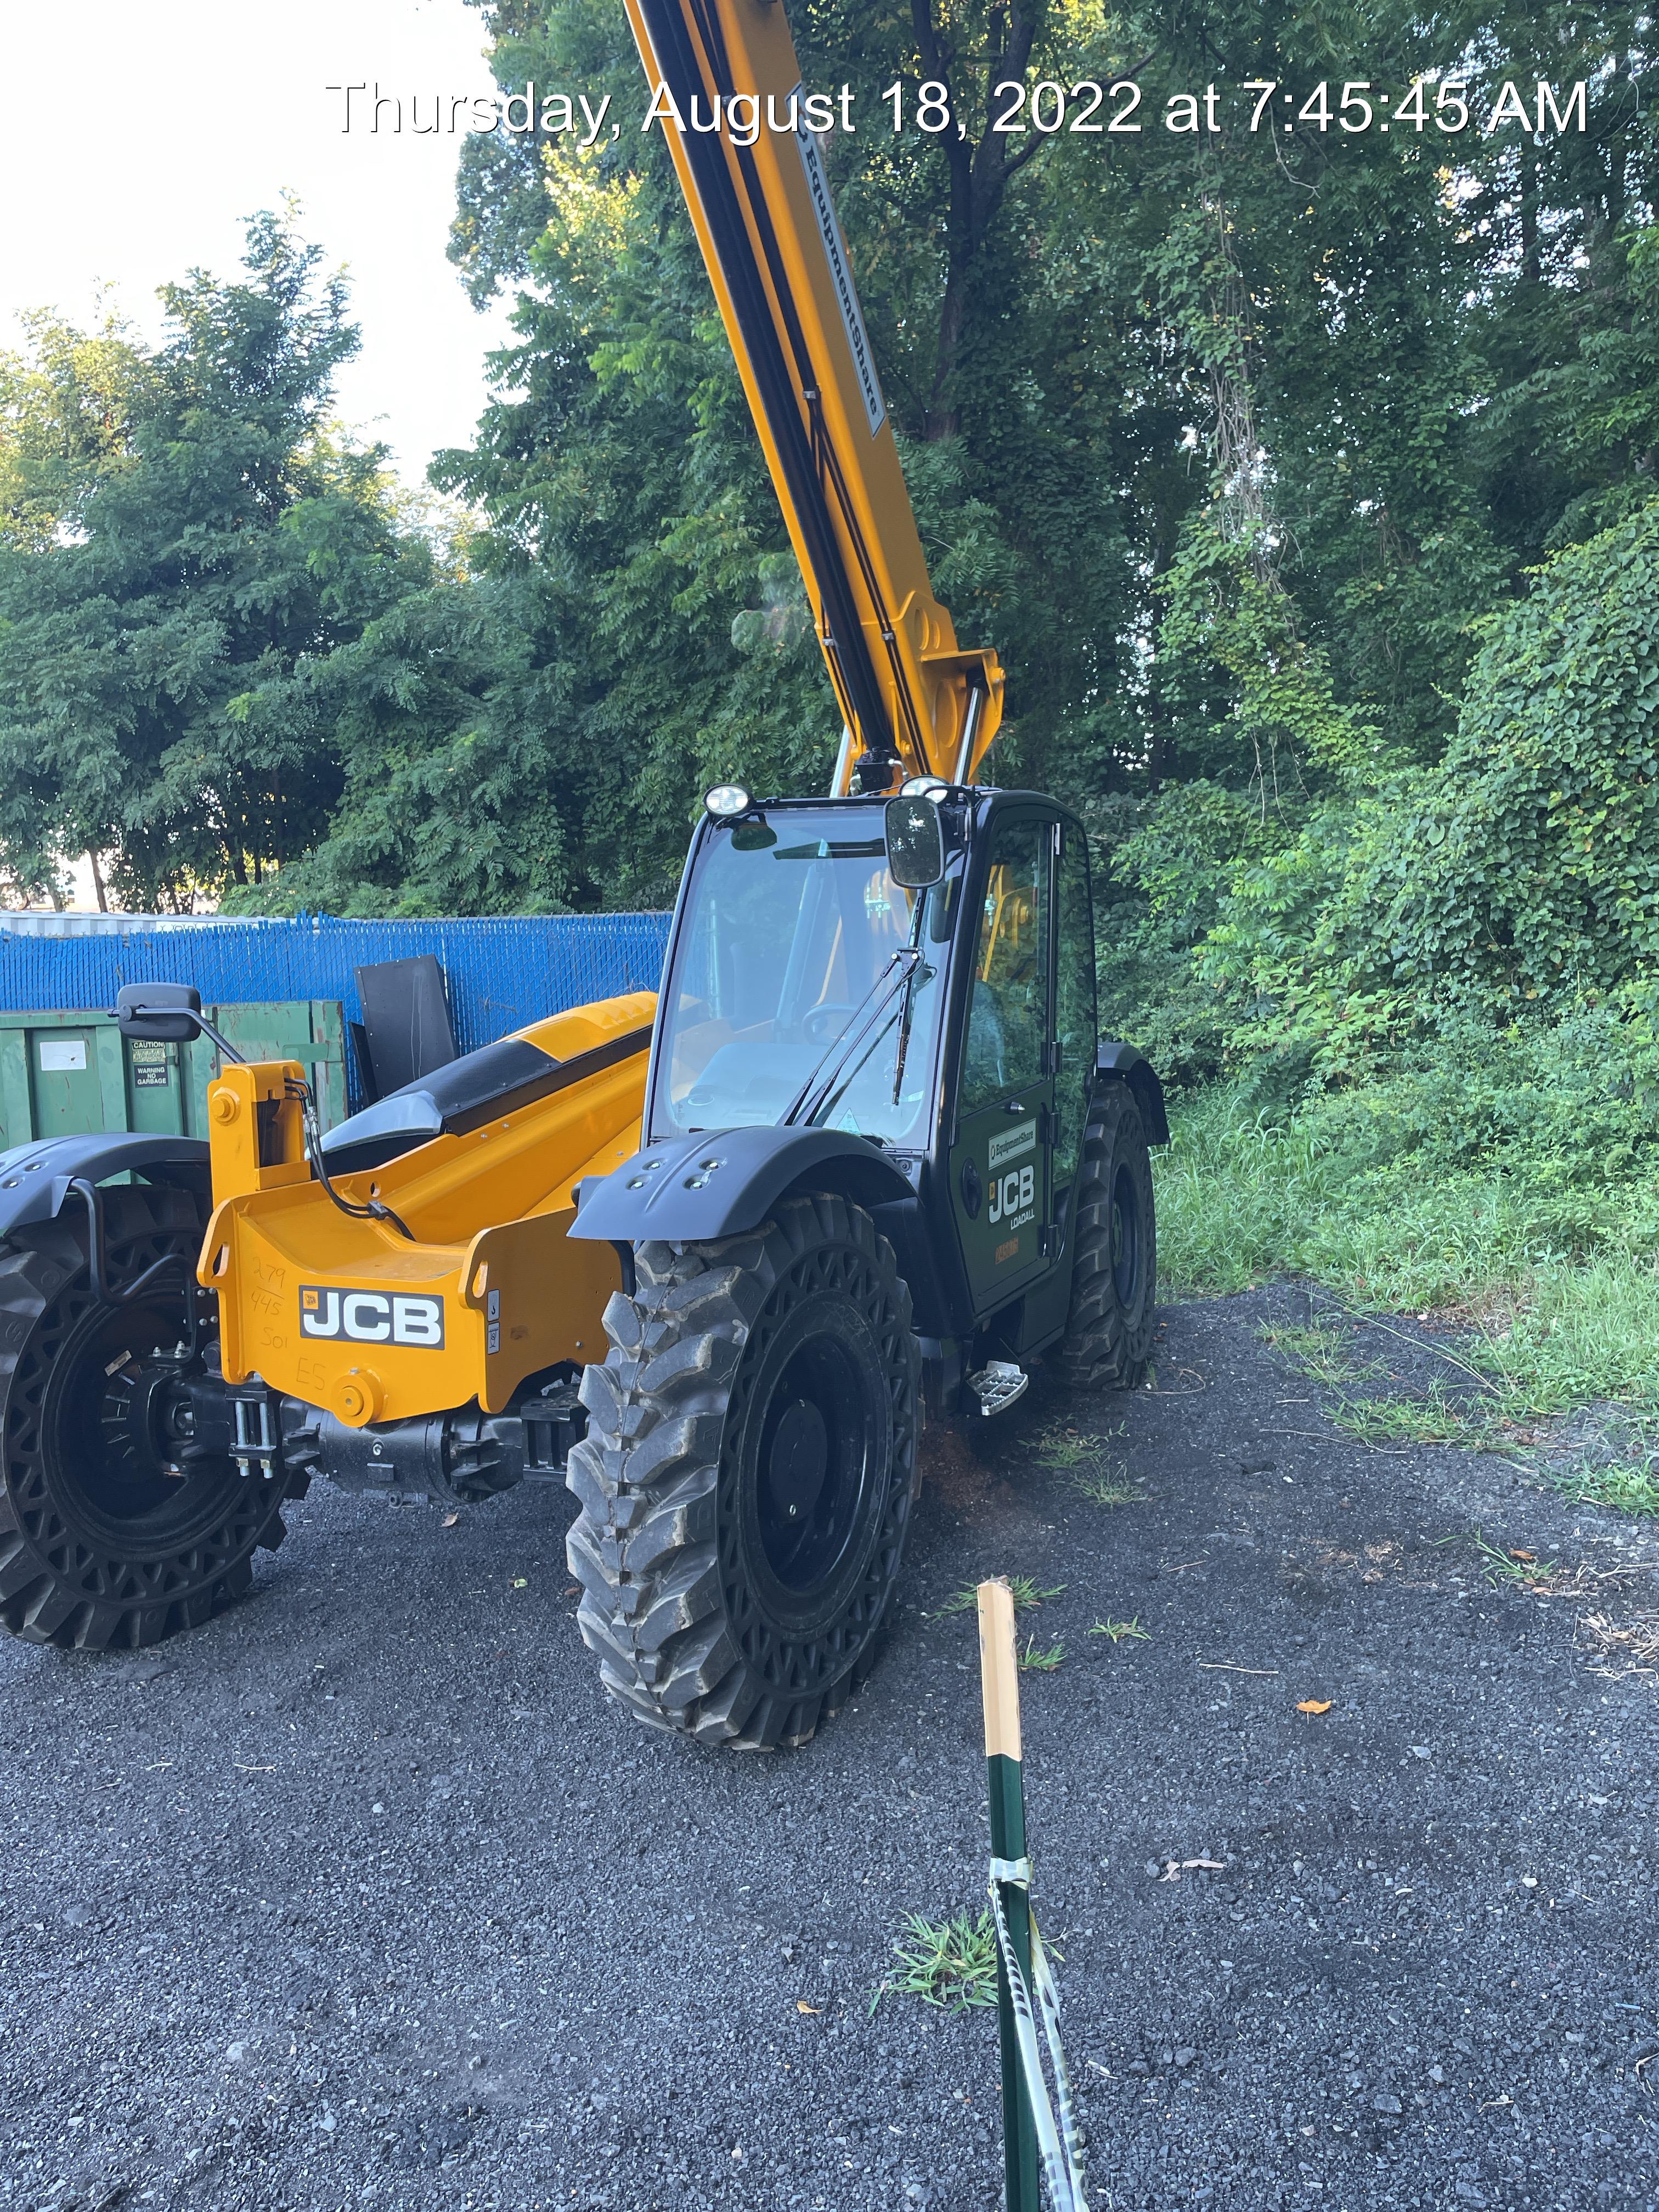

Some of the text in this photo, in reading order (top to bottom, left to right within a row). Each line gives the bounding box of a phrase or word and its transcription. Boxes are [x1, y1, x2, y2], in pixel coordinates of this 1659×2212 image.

[805, 146, 879, 417] EquipmentShare
[995, 1130, 1034, 1156] EquipmentShare
[989, 1165, 1035, 1223] JCB
[1011, 1208, 1035, 1231] LOADALL
[252, 1256, 286, 1289] 279
[251, 1290, 282, 1316] 445
[303, 1291, 441, 1345] JCB
